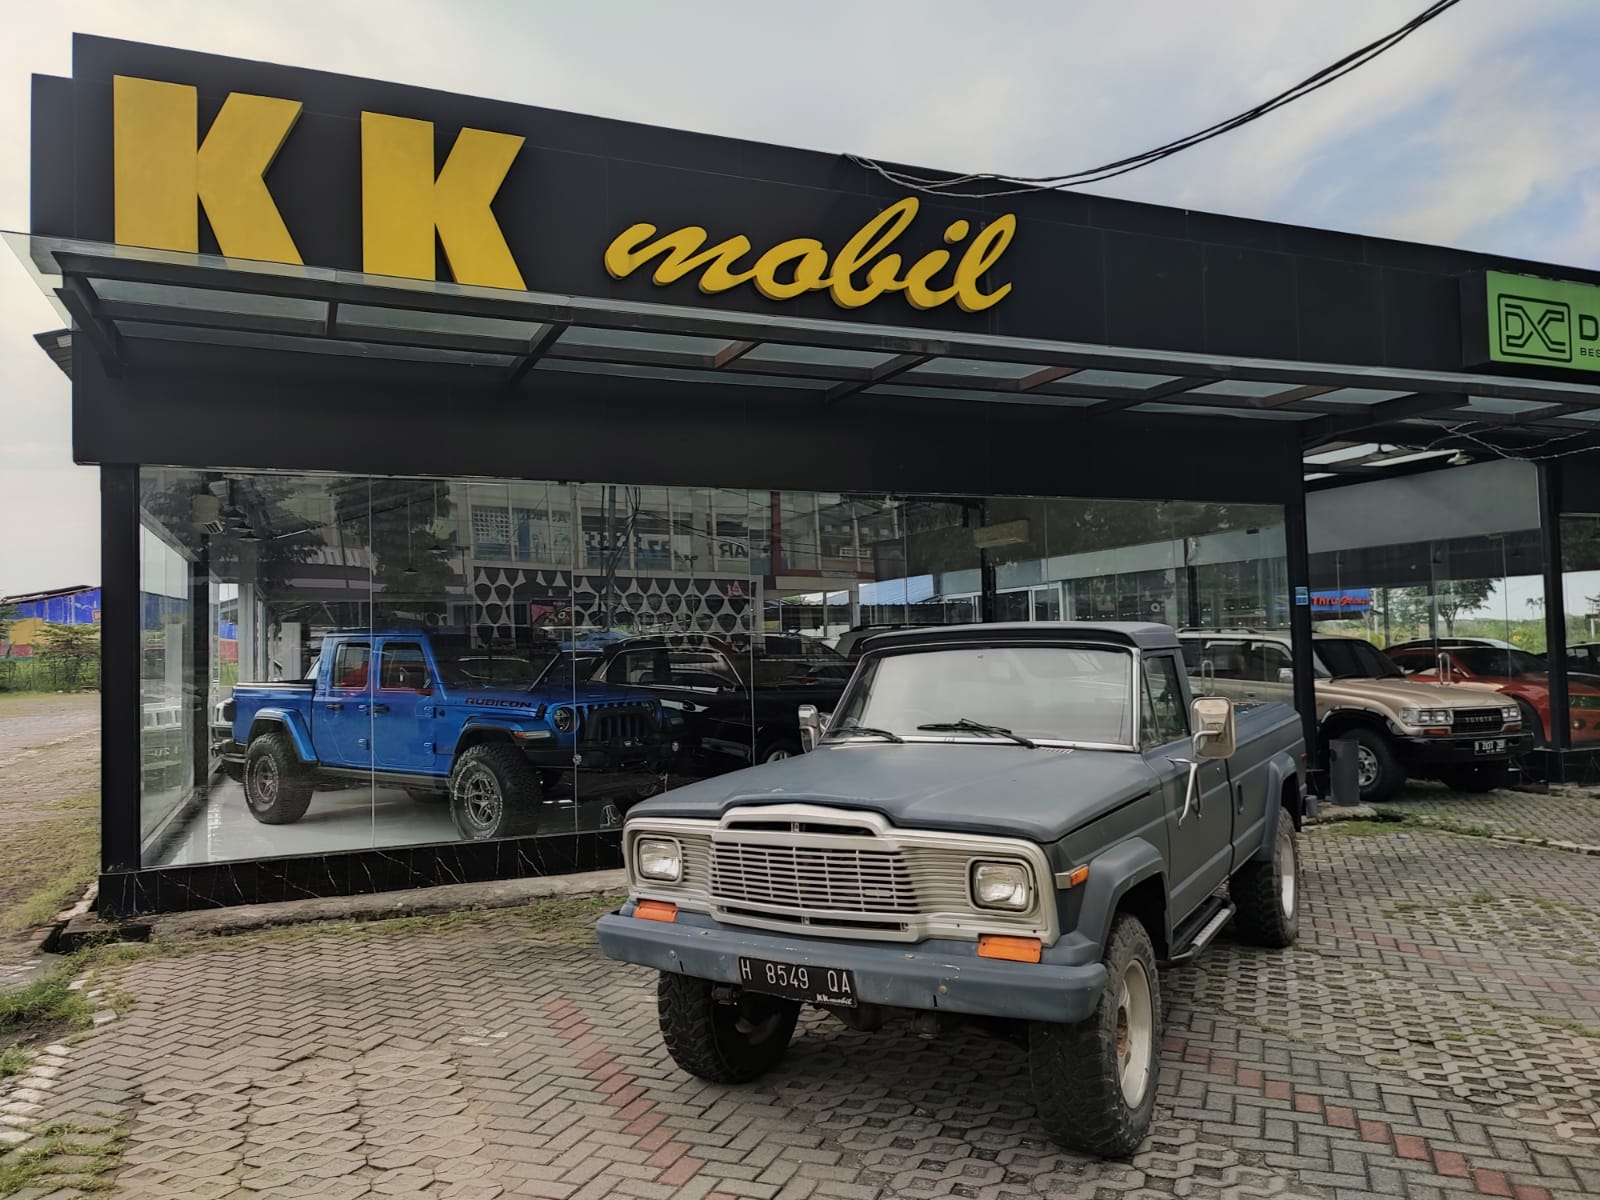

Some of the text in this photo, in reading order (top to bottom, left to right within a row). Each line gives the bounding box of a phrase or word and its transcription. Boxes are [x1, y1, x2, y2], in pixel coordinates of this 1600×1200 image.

[604, 197, 1017, 312] mobil
[465, 697, 532, 708] RUBICON
[740, 959, 851, 994] H 8549 QA
